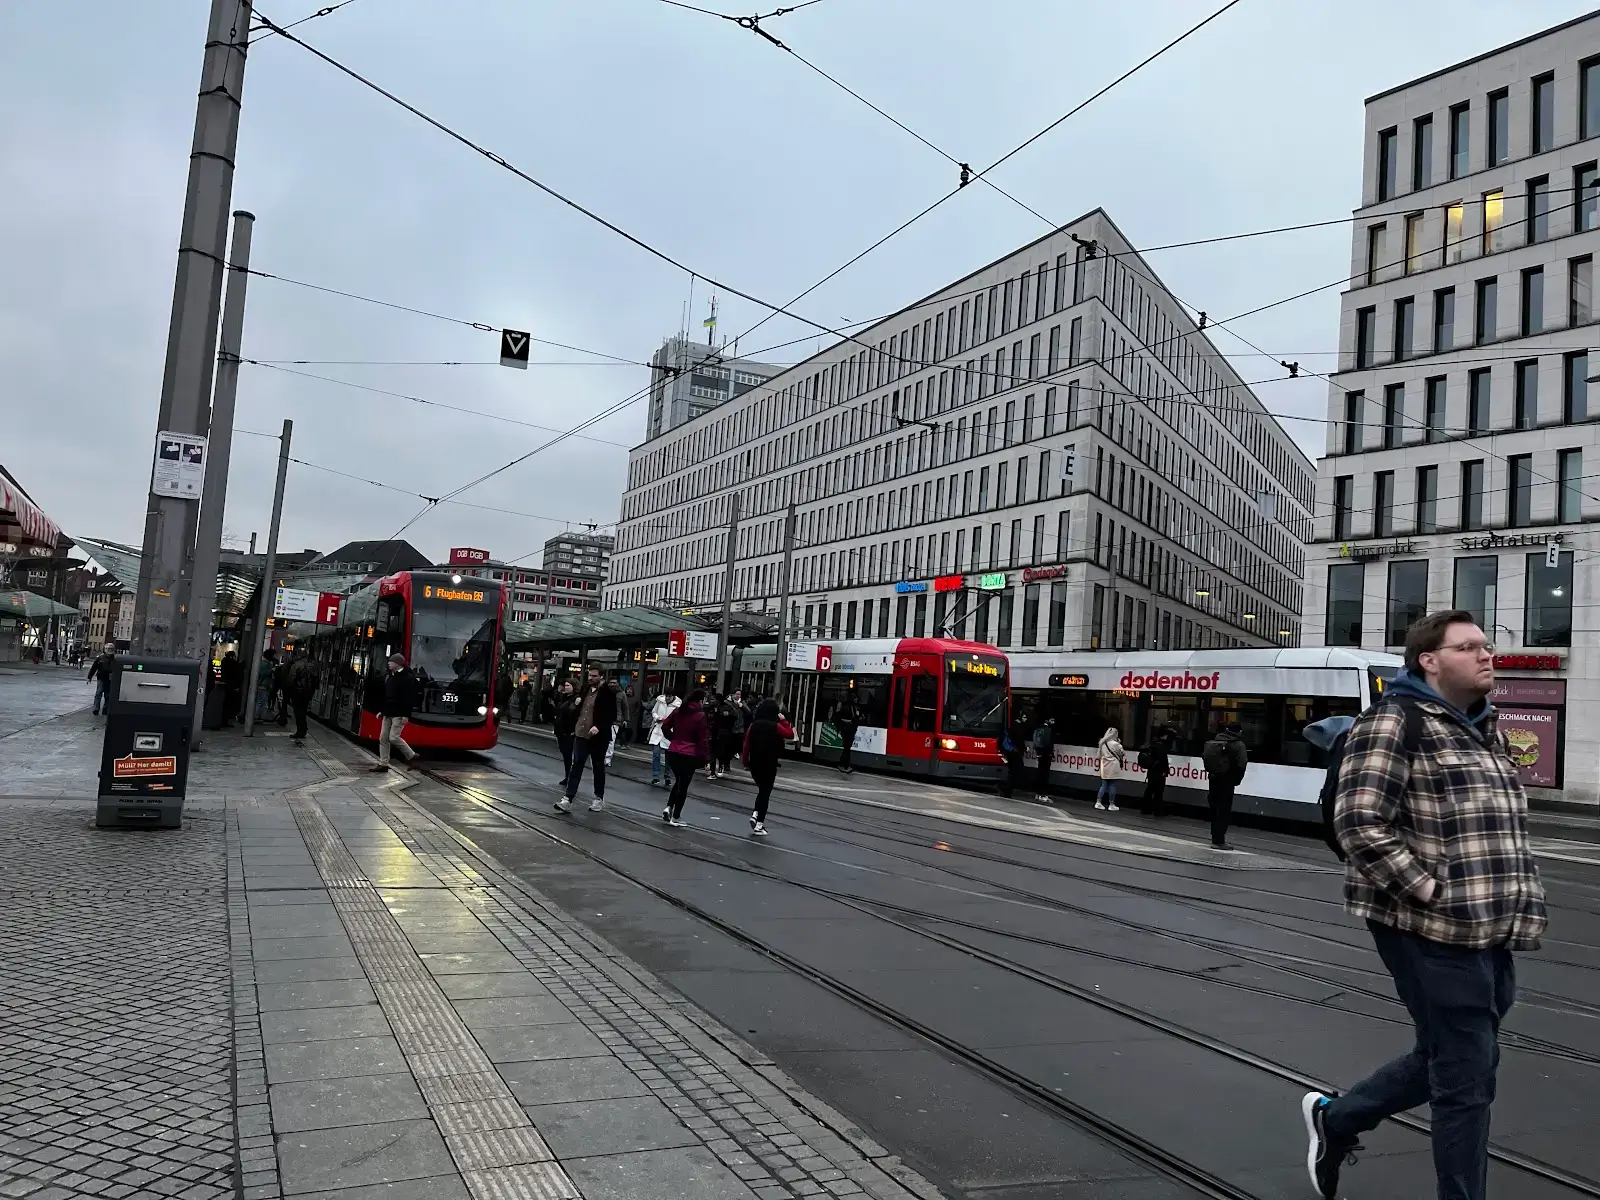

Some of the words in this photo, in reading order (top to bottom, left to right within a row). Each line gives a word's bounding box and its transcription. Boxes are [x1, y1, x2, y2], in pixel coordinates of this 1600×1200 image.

[1065, 455, 1075, 476] E
[457, 550, 468, 558] DGB
[469, 550, 484, 560] DGB
[1549, 547, 1556, 563] E
[425, 585, 432, 598] 6
[436, 588, 473, 600] Flughafen
[326, 606, 338, 622] F
[669, 640, 679, 655] E
[820, 656, 831, 670] D
[950, 659, 957, 673] 1
[1120, 670, 1220, 690] dodenhof
[1375, 675, 1383, 692] 1
[441, 694, 459, 703] 3215
[1498, 713, 1531, 722] ESCHMACK
[1532, 714, 1552, 723] NACH!
[974, 741, 986, 749] 3136
